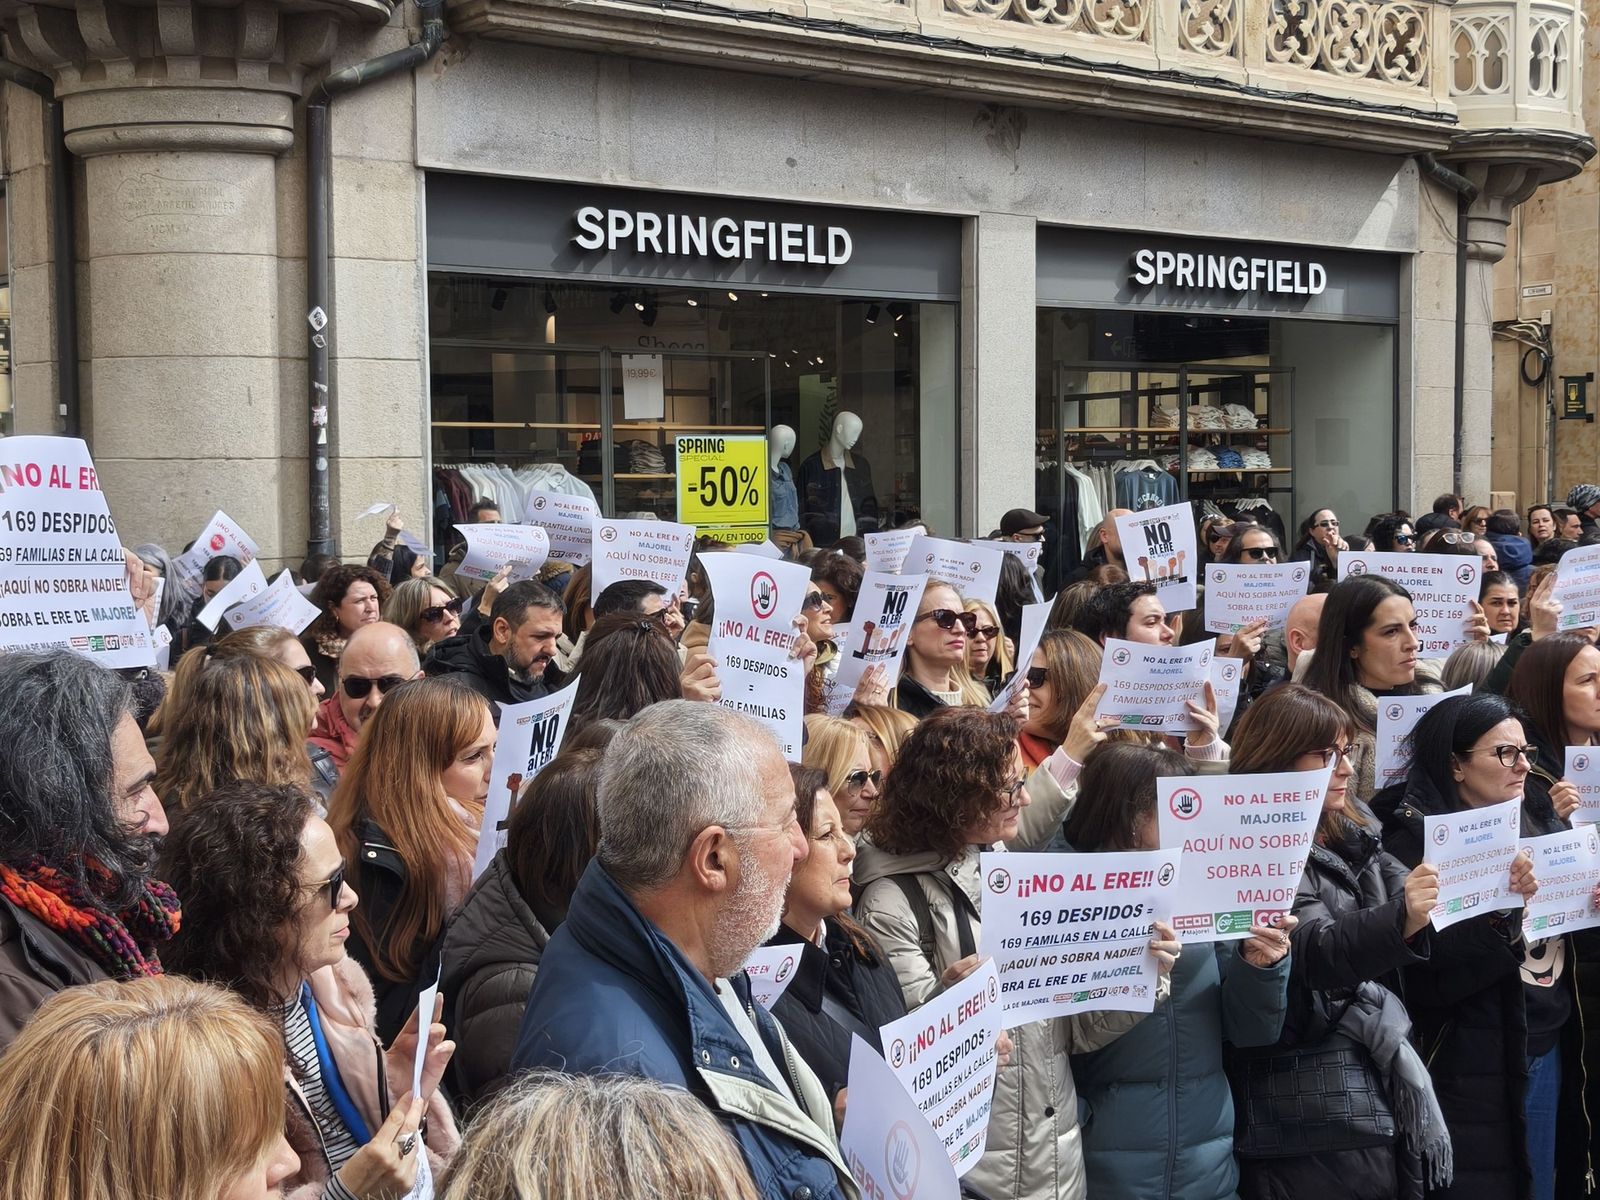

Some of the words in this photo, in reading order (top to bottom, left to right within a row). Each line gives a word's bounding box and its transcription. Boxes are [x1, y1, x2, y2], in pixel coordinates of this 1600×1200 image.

[575, 206, 853, 267] SPRINGFIELD
[1134, 248, 1327, 297] SPRINGFIELD
[627, 368, 656, 378] 19,99€
[678, 438, 725, 453] SPRING
[679, 454, 725, 462] SPECIAL
[49, 464, 71, 489] AL
[688, 466, 759, 507] -50%
[2, 510, 36, 532] 169
[42, 511, 115, 534] DESPIDOS
[558, 511, 583, 520] MAJOREL
[538, 520, 572, 532] PLANTILLA
[656, 533, 670, 541] ERE
[740, 532, 763, 540] TODO
[1143, 522, 1172, 546] NO
[638, 542, 672, 552] MAJOREL
[1149, 544, 1158, 555] al
[1160, 542, 1174, 553] ERE
[16, 548, 65, 562] FAMILIAS
[68, 548, 82, 562] EN
[85, 548, 97, 562] LA
[606, 550, 630, 560] AQUÍ
[632, 552, 646, 562] NO
[648, 555, 672, 566] SOBRA
[620, 567, 648, 578] SOBRA
[651, 571, 659, 579] EL
[1381, 565, 1394, 573] NO
[1397, 566, 1409, 574] AL
[1411, 566, 1429, 574] ERE
[1431, 567, 1443, 575] EN
[34, 579, 49, 594] NO
[53, 579, 89, 593] SOBRA
[1216, 590, 1236, 599] AQUÍ
[1252, 591, 1277, 599] SOBRA
[1279, 589, 1300, 597] NADIE
[882, 591, 908, 614] NO
[1455, 594, 1467, 604] DE
[1563, 591, 1585, 601] SOBRA
[1227, 603, 1254, 611] SOBRA
[1431, 609, 1444, 619] DE
[1447, 609, 1463, 619] 169
[34, 612, 49, 626] EL
[50, 611, 73, 624] ERE
[74, 610, 90, 623] DE
[880, 614, 889, 625] al
[890, 613, 902, 624] ERE
[719, 620, 743, 638] ¡¡NO
[746, 625, 760, 642] AL
[764, 630, 794, 650] ERE!!
[1426, 641, 1441, 650] UGT
[726, 655, 741, 669] 169
[743, 658, 788, 679] DESPIDOS
[1113, 680, 1130, 690] 169
[1133, 682, 1173, 691] DESPIDOS
[1175, 681, 1189, 690] SON
[1113, 695, 1153, 704] FAMILIAS
[1154, 695, 1165, 704] EN
[1167, 695, 1176, 704] LA
[1177, 692, 1198, 702] CALLE
[737, 702, 786, 720] FAMILIAS
[1144, 716, 1163, 724] CGT
[529, 715, 558, 757] NO
[528, 753, 538, 771] al
[540, 745, 554, 767] ERE
[1224, 794, 1245, 806] NO
[1250, 793, 1268, 804] AL
[1273, 792, 1301, 803] ERE
[1305, 789, 1320, 800] EN
[1240, 811, 1307, 825] MAJOREL
[1458, 824, 1469, 833] NO
[1470, 822, 1479, 830] AL
[1480, 819, 1492, 829] ERE
[1493, 817, 1502, 825] EN
[1182, 834, 1225, 853] AQUÍ
[1229, 836, 1254, 850] NO
[1259, 832, 1309, 849] SOBRA
[1464, 832, 1494, 844] MAJOREL
[1543, 848, 1552, 856] NO
[1554, 845, 1561, 853] AL
[1562, 843, 1573, 852] ERE
[1451, 853, 1486, 869] DESPIDOS
[1486, 848, 1502, 860] SON
[1549, 856, 1577, 866] MAJOREL
[1207, 863, 1262, 880] SOBRA
[1268, 863, 1285, 877] EL
[1469, 869, 1479, 880] EN
[1480, 866, 1489, 876] LA
[1490, 861, 1511, 874] CALLE
[1017, 873, 1064, 898] ¡¡NO
[1070, 873, 1097, 892] AL
[1103, 870, 1154, 889] ERE!!
[1537, 874, 1571, 888] DESPIDOS
[1572, 872, 1586, 882] SON
[1555, 889, 1565, 900] EN
[1566, 887, 1575, 897] LA
[1576, 884, 1596, 896] CALLE
[1464, 893, 1479, 908] CGT
[1020, 910, 1051, 927] 169
[1057, 903, 1144, 924] DESPIDOS
[1175, 916, 1211, 928] CCOO
[1549, 913, 1564, 926] CGT
[1000, 938, 1022, 950] 169
[1025, 932, 1080, 947] FAMILIAS
[1083, 931, 1099, 941] EN
[1102, 928, 1117, 939] LA
[1121, 924, 1154, 938] CALLE
[1000, 955, 1037, 974] ¡¡AQUÍ
[1040, 956, 1056, 967] NO
[1060, 951, 1100, 964] SOBRA
[1103, 946, 1144, 960] NADIE!!
[760, 965, 770, 974] EN
[1028, 978, 1042, 989] EL
[1045, 976, 1068, 987] ERE
[1071, 973, 1087, 984] DE
[1091, 965, 1143, 981] MAJOREL
[1021, 997, 1049, 1007] MAJOREL
[1090, 989, 1107, 999] CGT
[1108, 986, 1122, 995] UGT
[909, 1025, 935, 1065] ¡¡NO
[939, 1013, 954, 1039] AL
[958, 990, 986, 1026] ERE!!
[911, 1068, 933, 1094] 169
[935, 1028, 985, 1079] DESPIDOS
[918, 1081, 953, 1113] FAMILIAS
[953, 1072, 963, 1088] EN
[964, 1065, 973, 1081] LA
[974, 1047, 994, 1072] CALLE
[931, 1115, 944, 1130] NO
[946, 1098, 967, 1122] SOBRA
[968, 1074, 992, 1104] NADIE!!
[955, 1124, 964, 1137] DE
